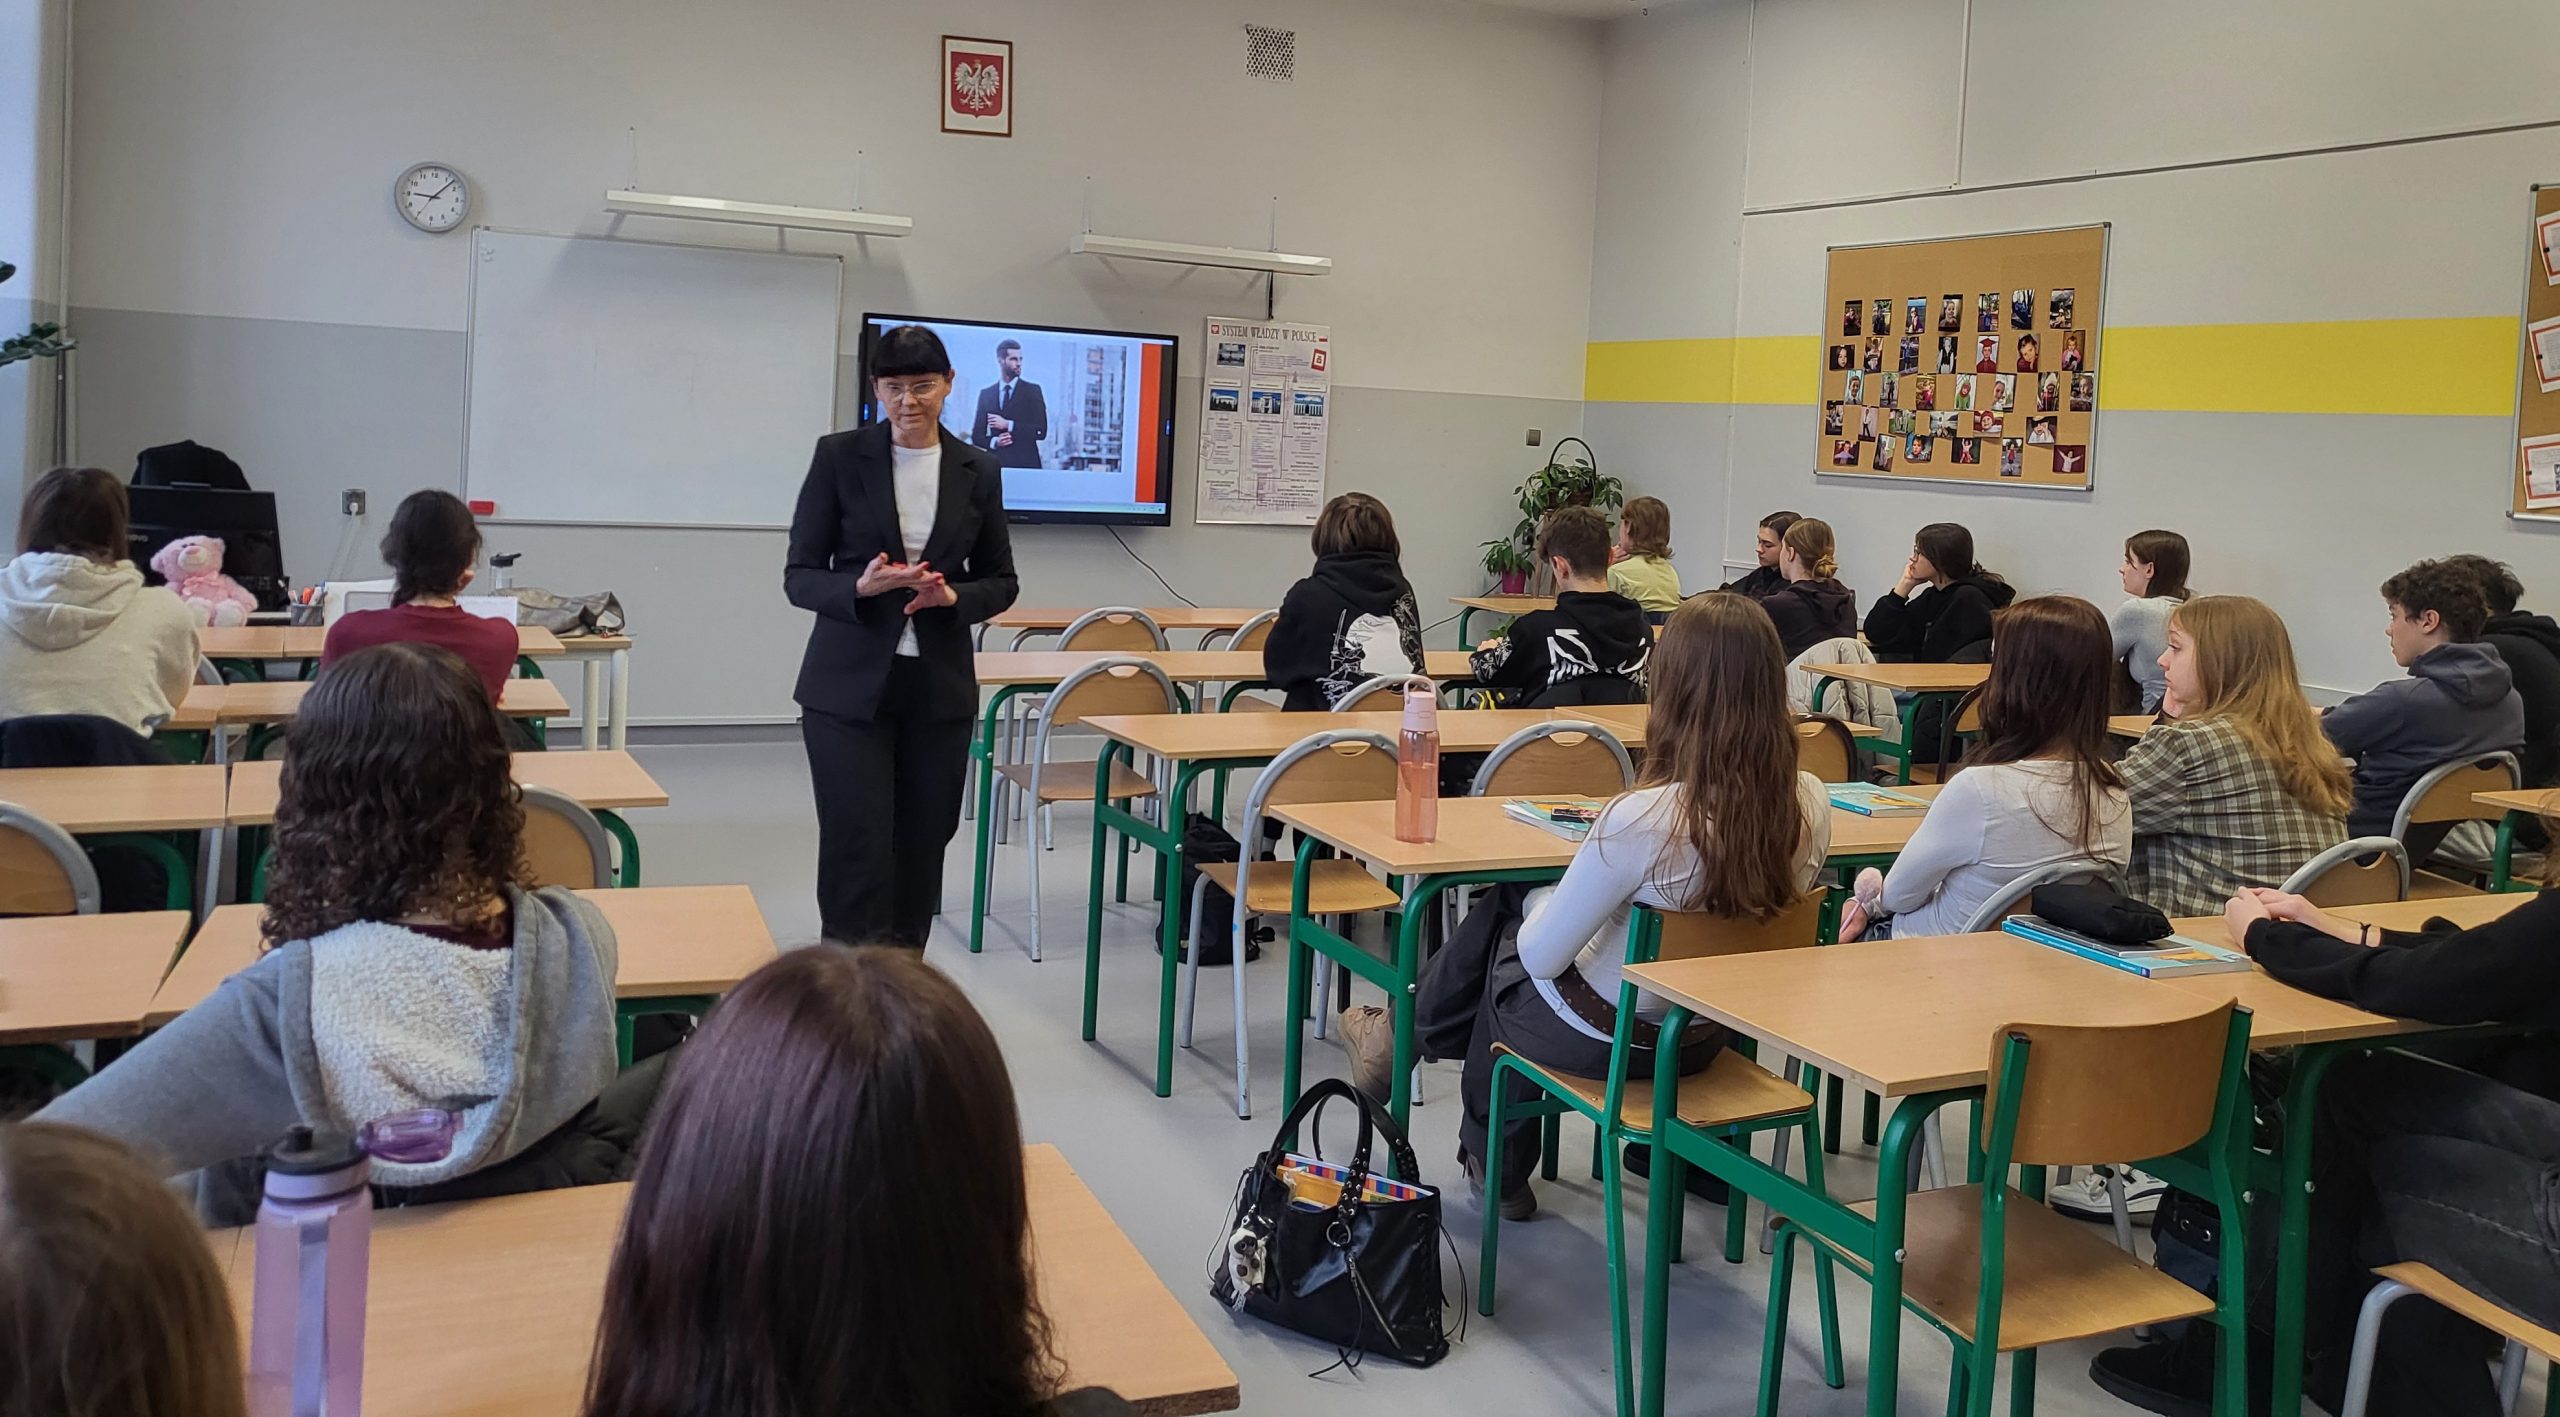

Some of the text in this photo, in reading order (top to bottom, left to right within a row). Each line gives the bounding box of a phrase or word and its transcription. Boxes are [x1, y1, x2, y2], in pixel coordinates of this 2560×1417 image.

[1221, 325, 1317, 343] SYSTEM WŁADZY W POLSCE
